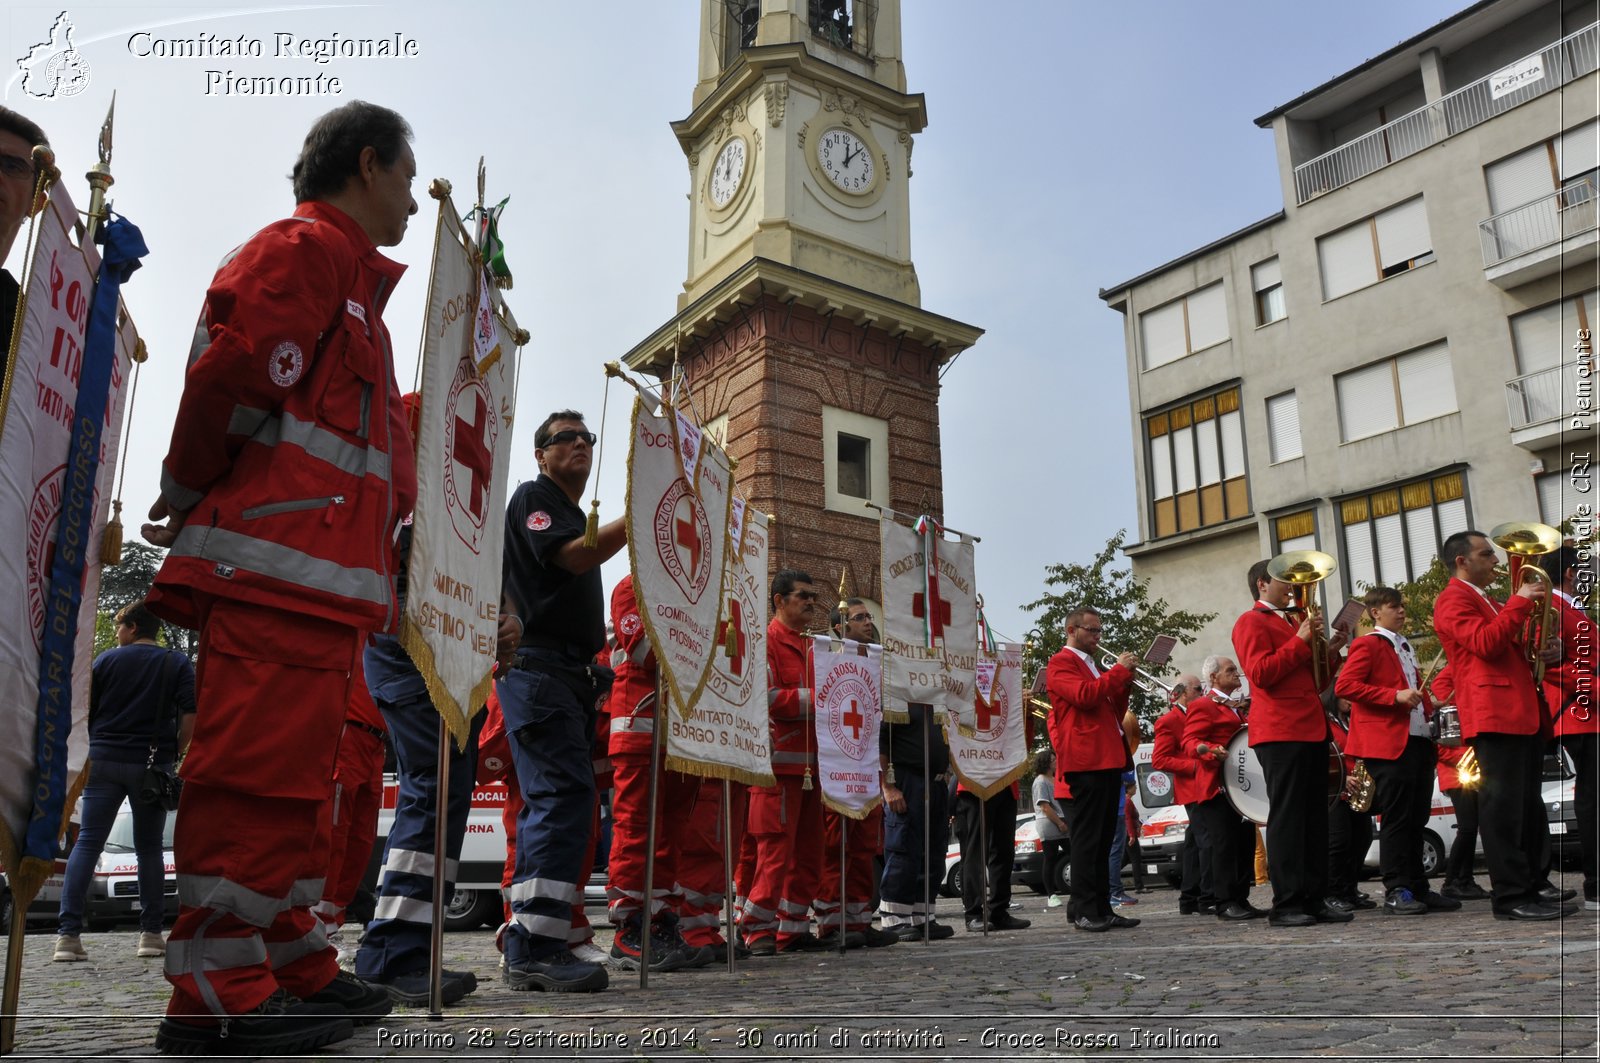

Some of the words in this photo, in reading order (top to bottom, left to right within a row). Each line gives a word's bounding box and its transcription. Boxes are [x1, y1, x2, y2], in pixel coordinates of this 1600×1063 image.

[1495, 66, 1541, 92] AFFITTA
[34, 652, 64, 822] VOLONTARI
[53, 584, 73, 636] DEL
[63, 416, 96, 566] SOCCORSO
[816, 672, 836, 708] CROCE
[834, 662, 858, 678] ROSSA
[860, 667, 880, 715] ITALIANA
[690, 708, 733, 726] OMITATO
[672, 722, 715, 744] BORGO
[720, 731, 731, 745] S.
[471, 792, 508, 801] LOCAL
